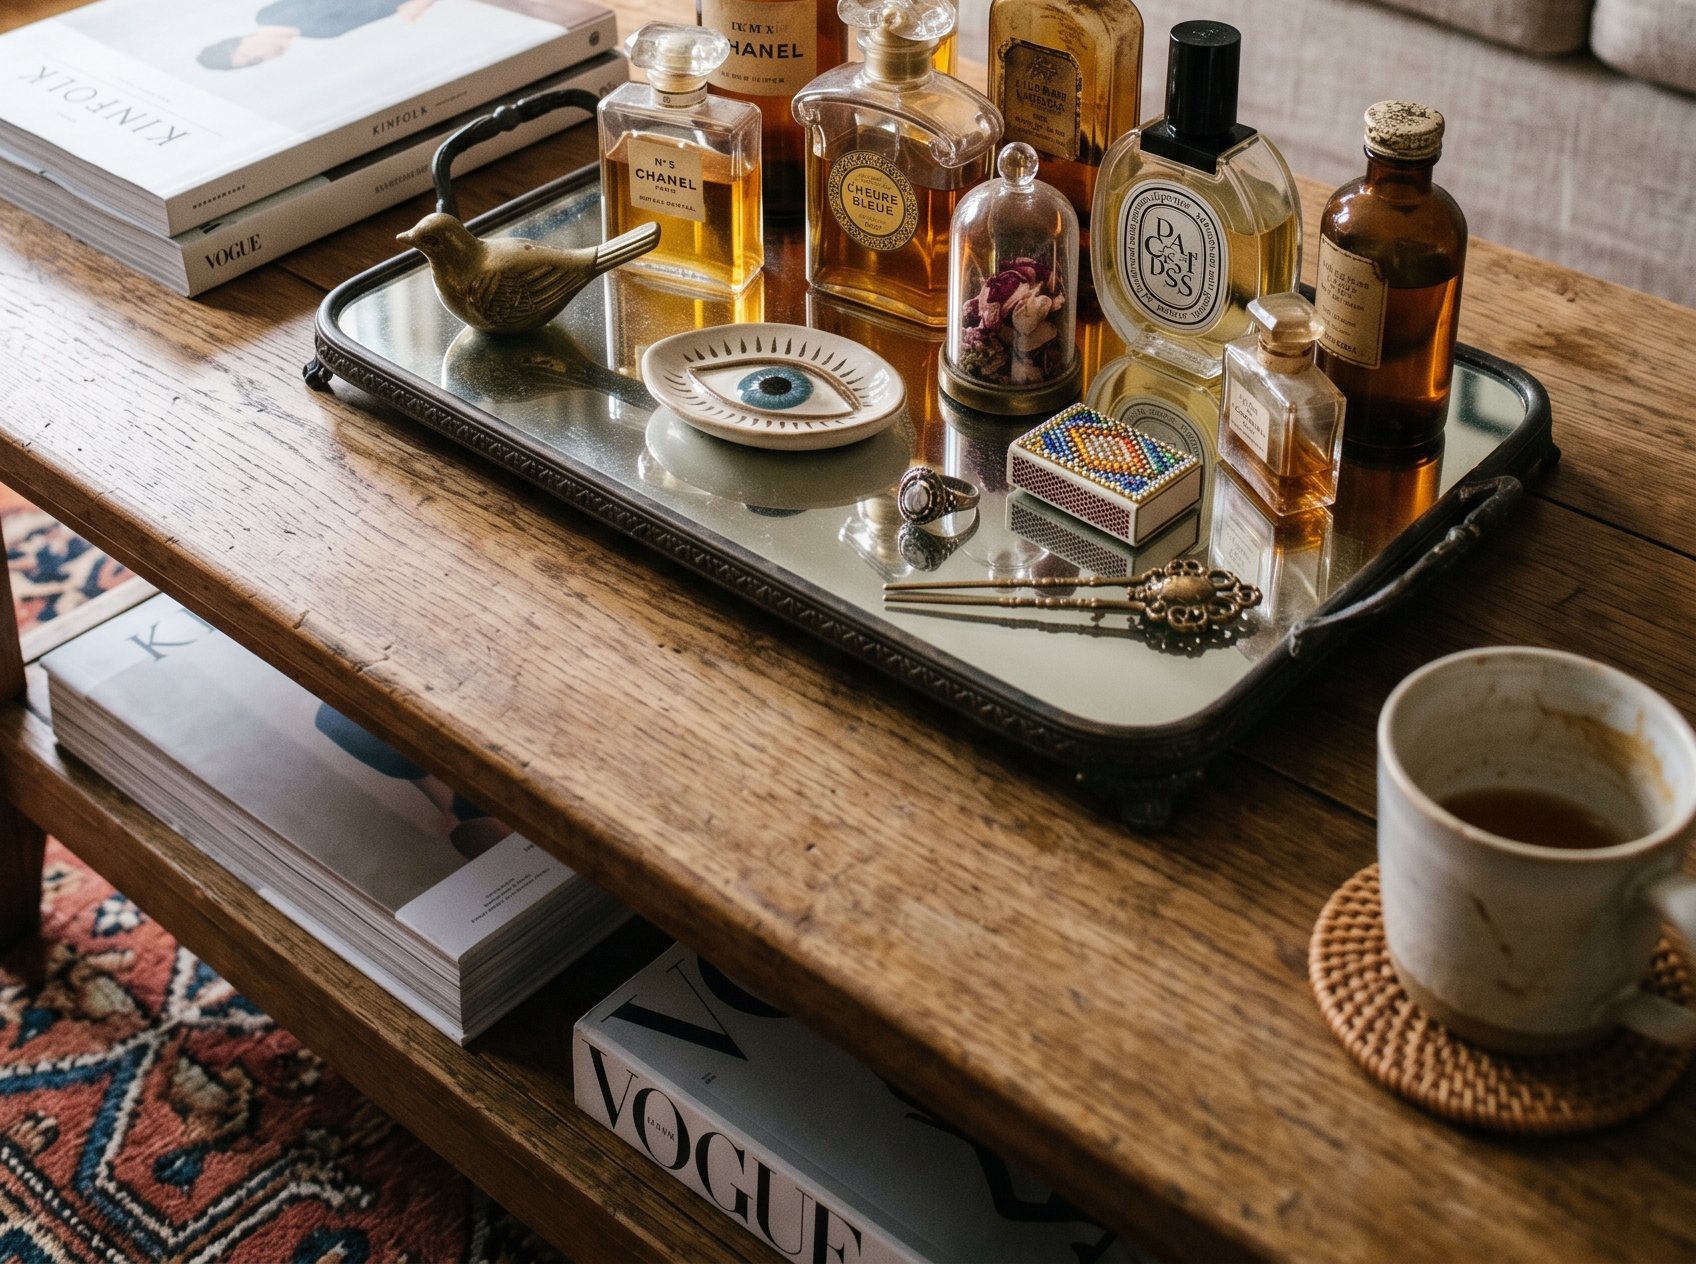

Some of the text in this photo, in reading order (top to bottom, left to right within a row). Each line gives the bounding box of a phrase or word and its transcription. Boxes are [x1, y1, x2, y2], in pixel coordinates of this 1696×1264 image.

[727, 39, 804, 59] HANEL
[18, 65, 190, 147] KINFOLK
[372, 105, 428, 137] KINFOLK
[635, 168, 697, 191] CHANEL
[852, 196, 894, 216] BLEUE
[205, 234, 262, 269] VOGUE
